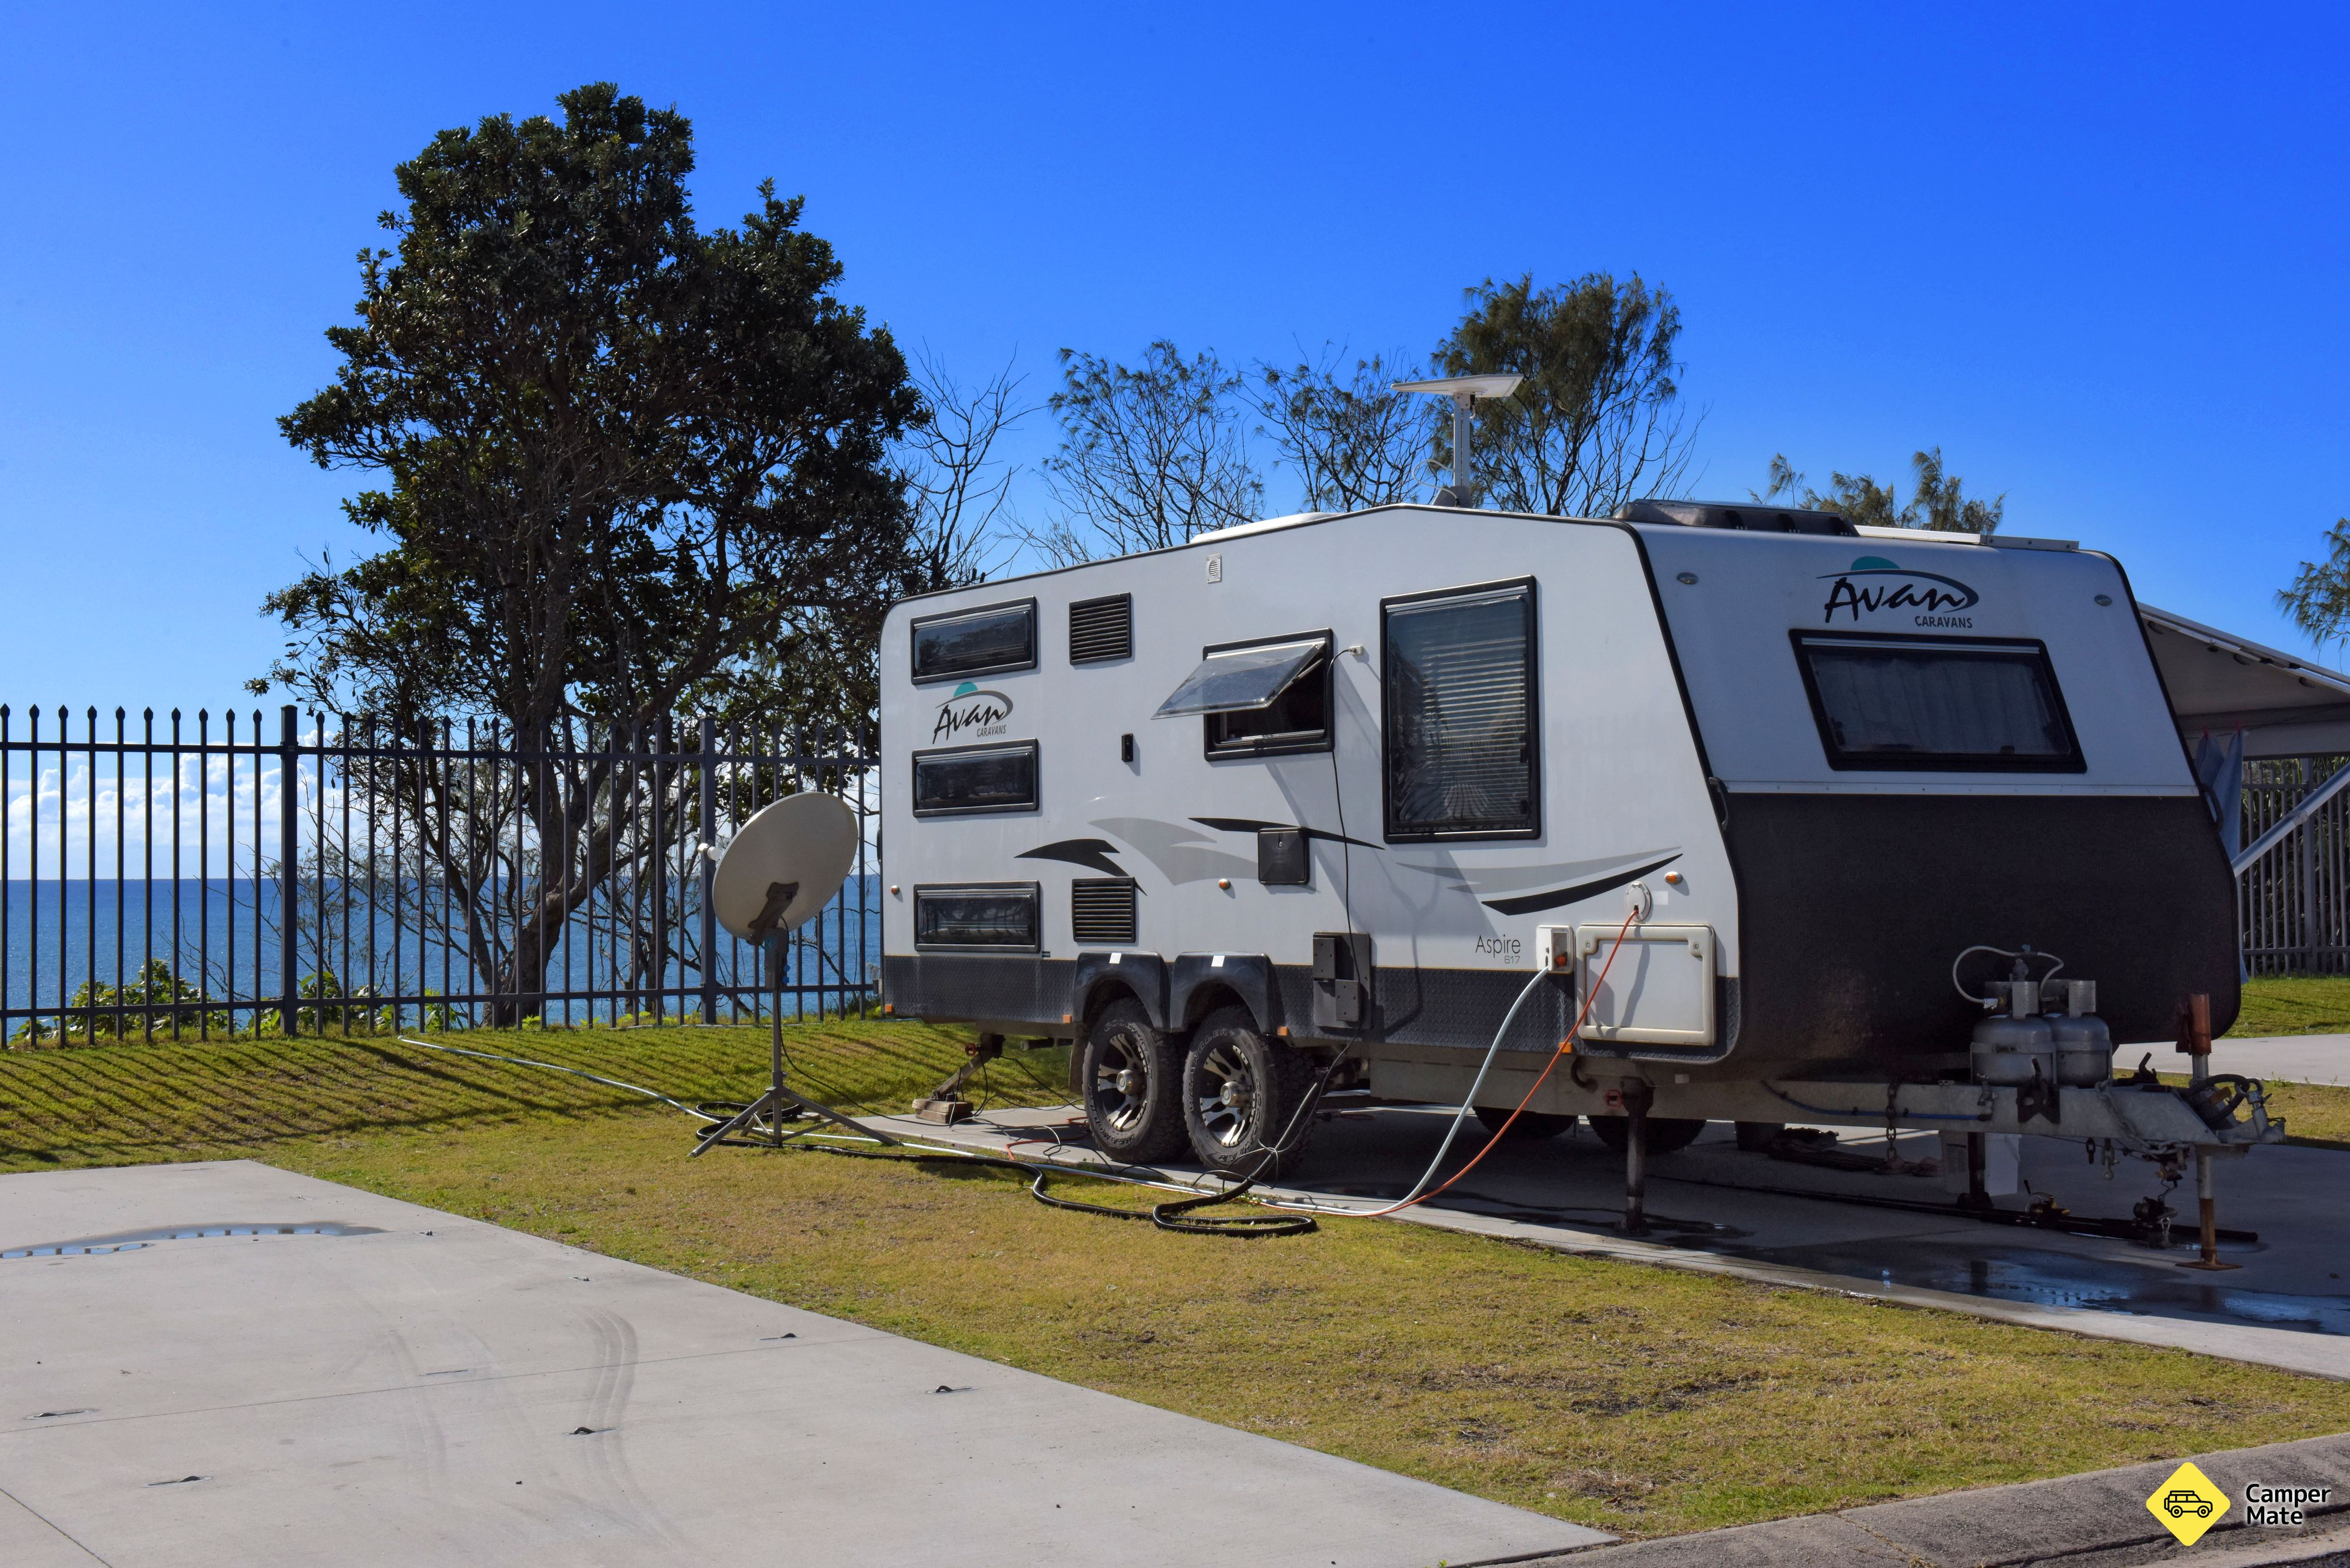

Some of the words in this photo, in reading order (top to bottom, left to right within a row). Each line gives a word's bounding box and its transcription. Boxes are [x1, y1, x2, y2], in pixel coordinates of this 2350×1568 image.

[1824, 577, 1965, 623] Avan
[1914, 616, 1973, 629] CARAVANS
[932, 705, 1005, 744] Avan
[977, 725, 1006, 738] CARAVANS
[1475, 934, 1521, 959] Aspire
[1504, 955, 1521, 964] 617
[1186, 1027, 1229, 1112] WRANGLER
